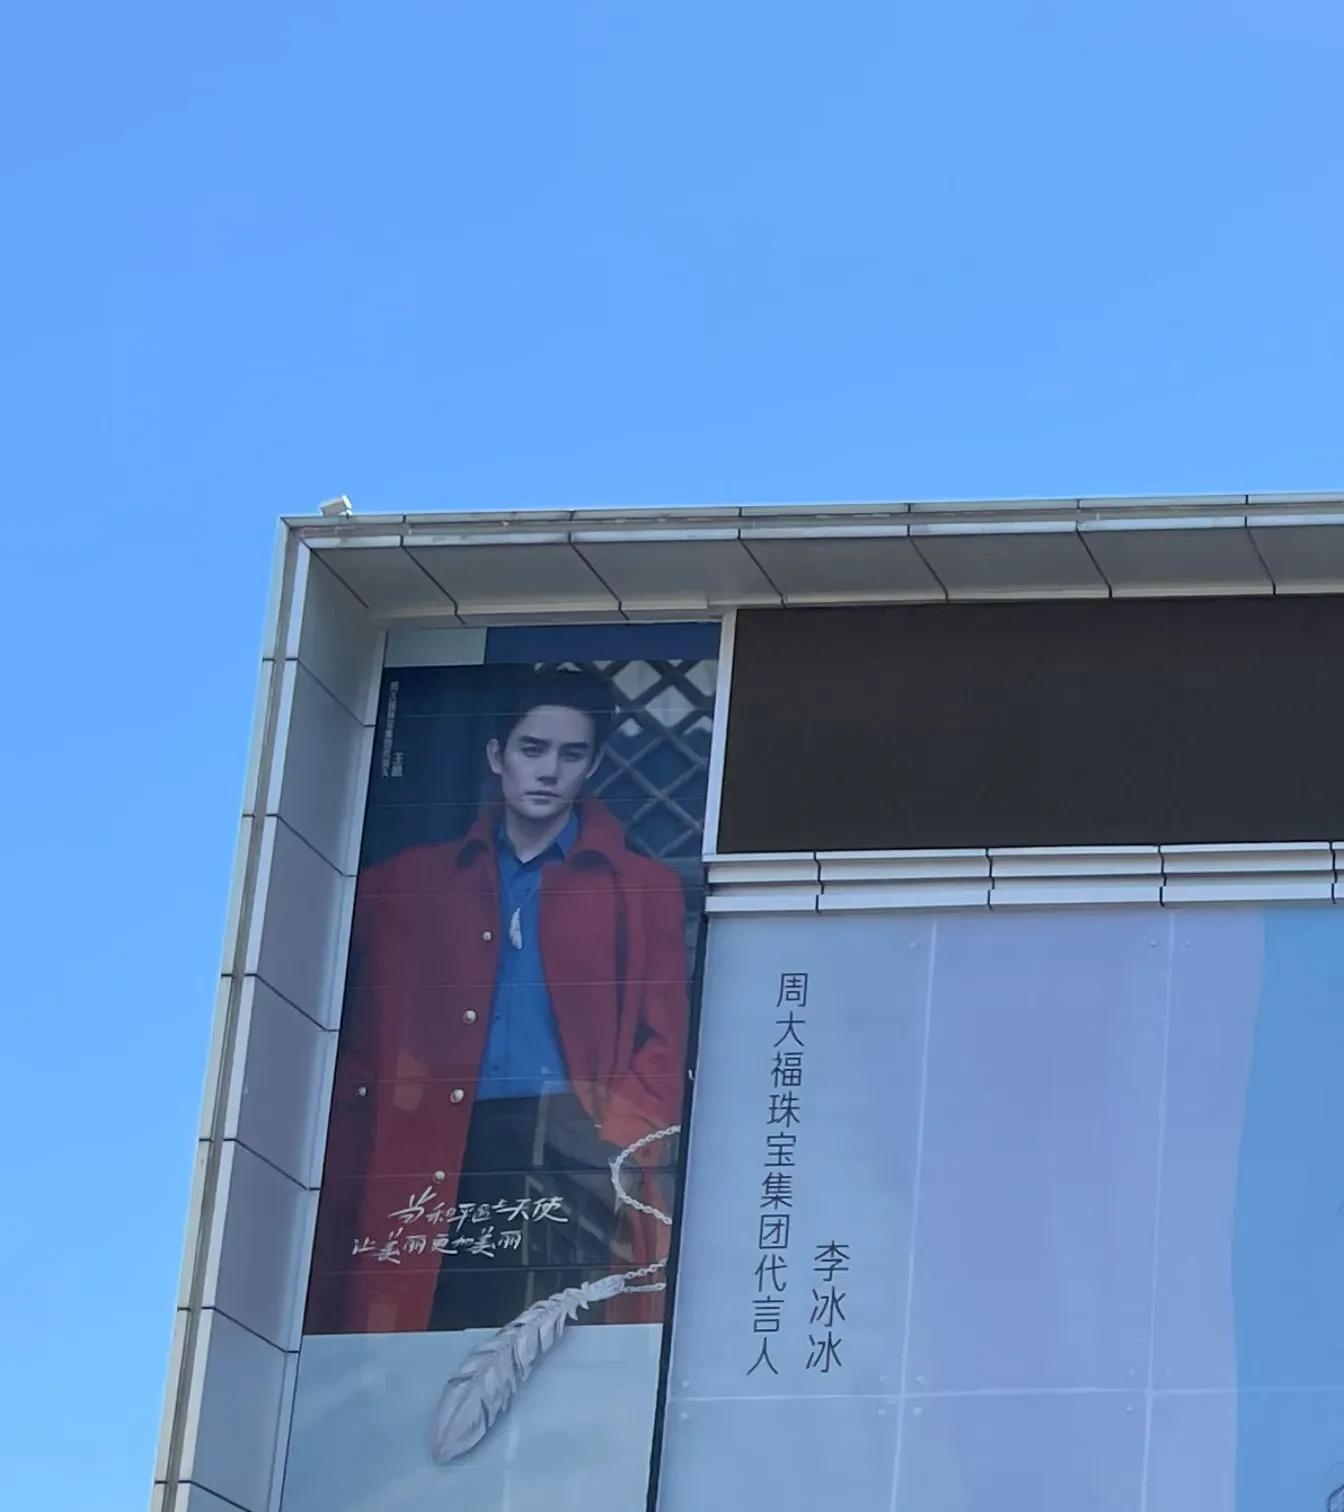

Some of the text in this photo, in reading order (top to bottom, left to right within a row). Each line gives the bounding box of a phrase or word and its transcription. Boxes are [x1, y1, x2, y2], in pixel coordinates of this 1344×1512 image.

[746, 972, 809, 1376] 周大福珠宝集团代言人
[806, 1239, 850, 1373] 李冰冰
